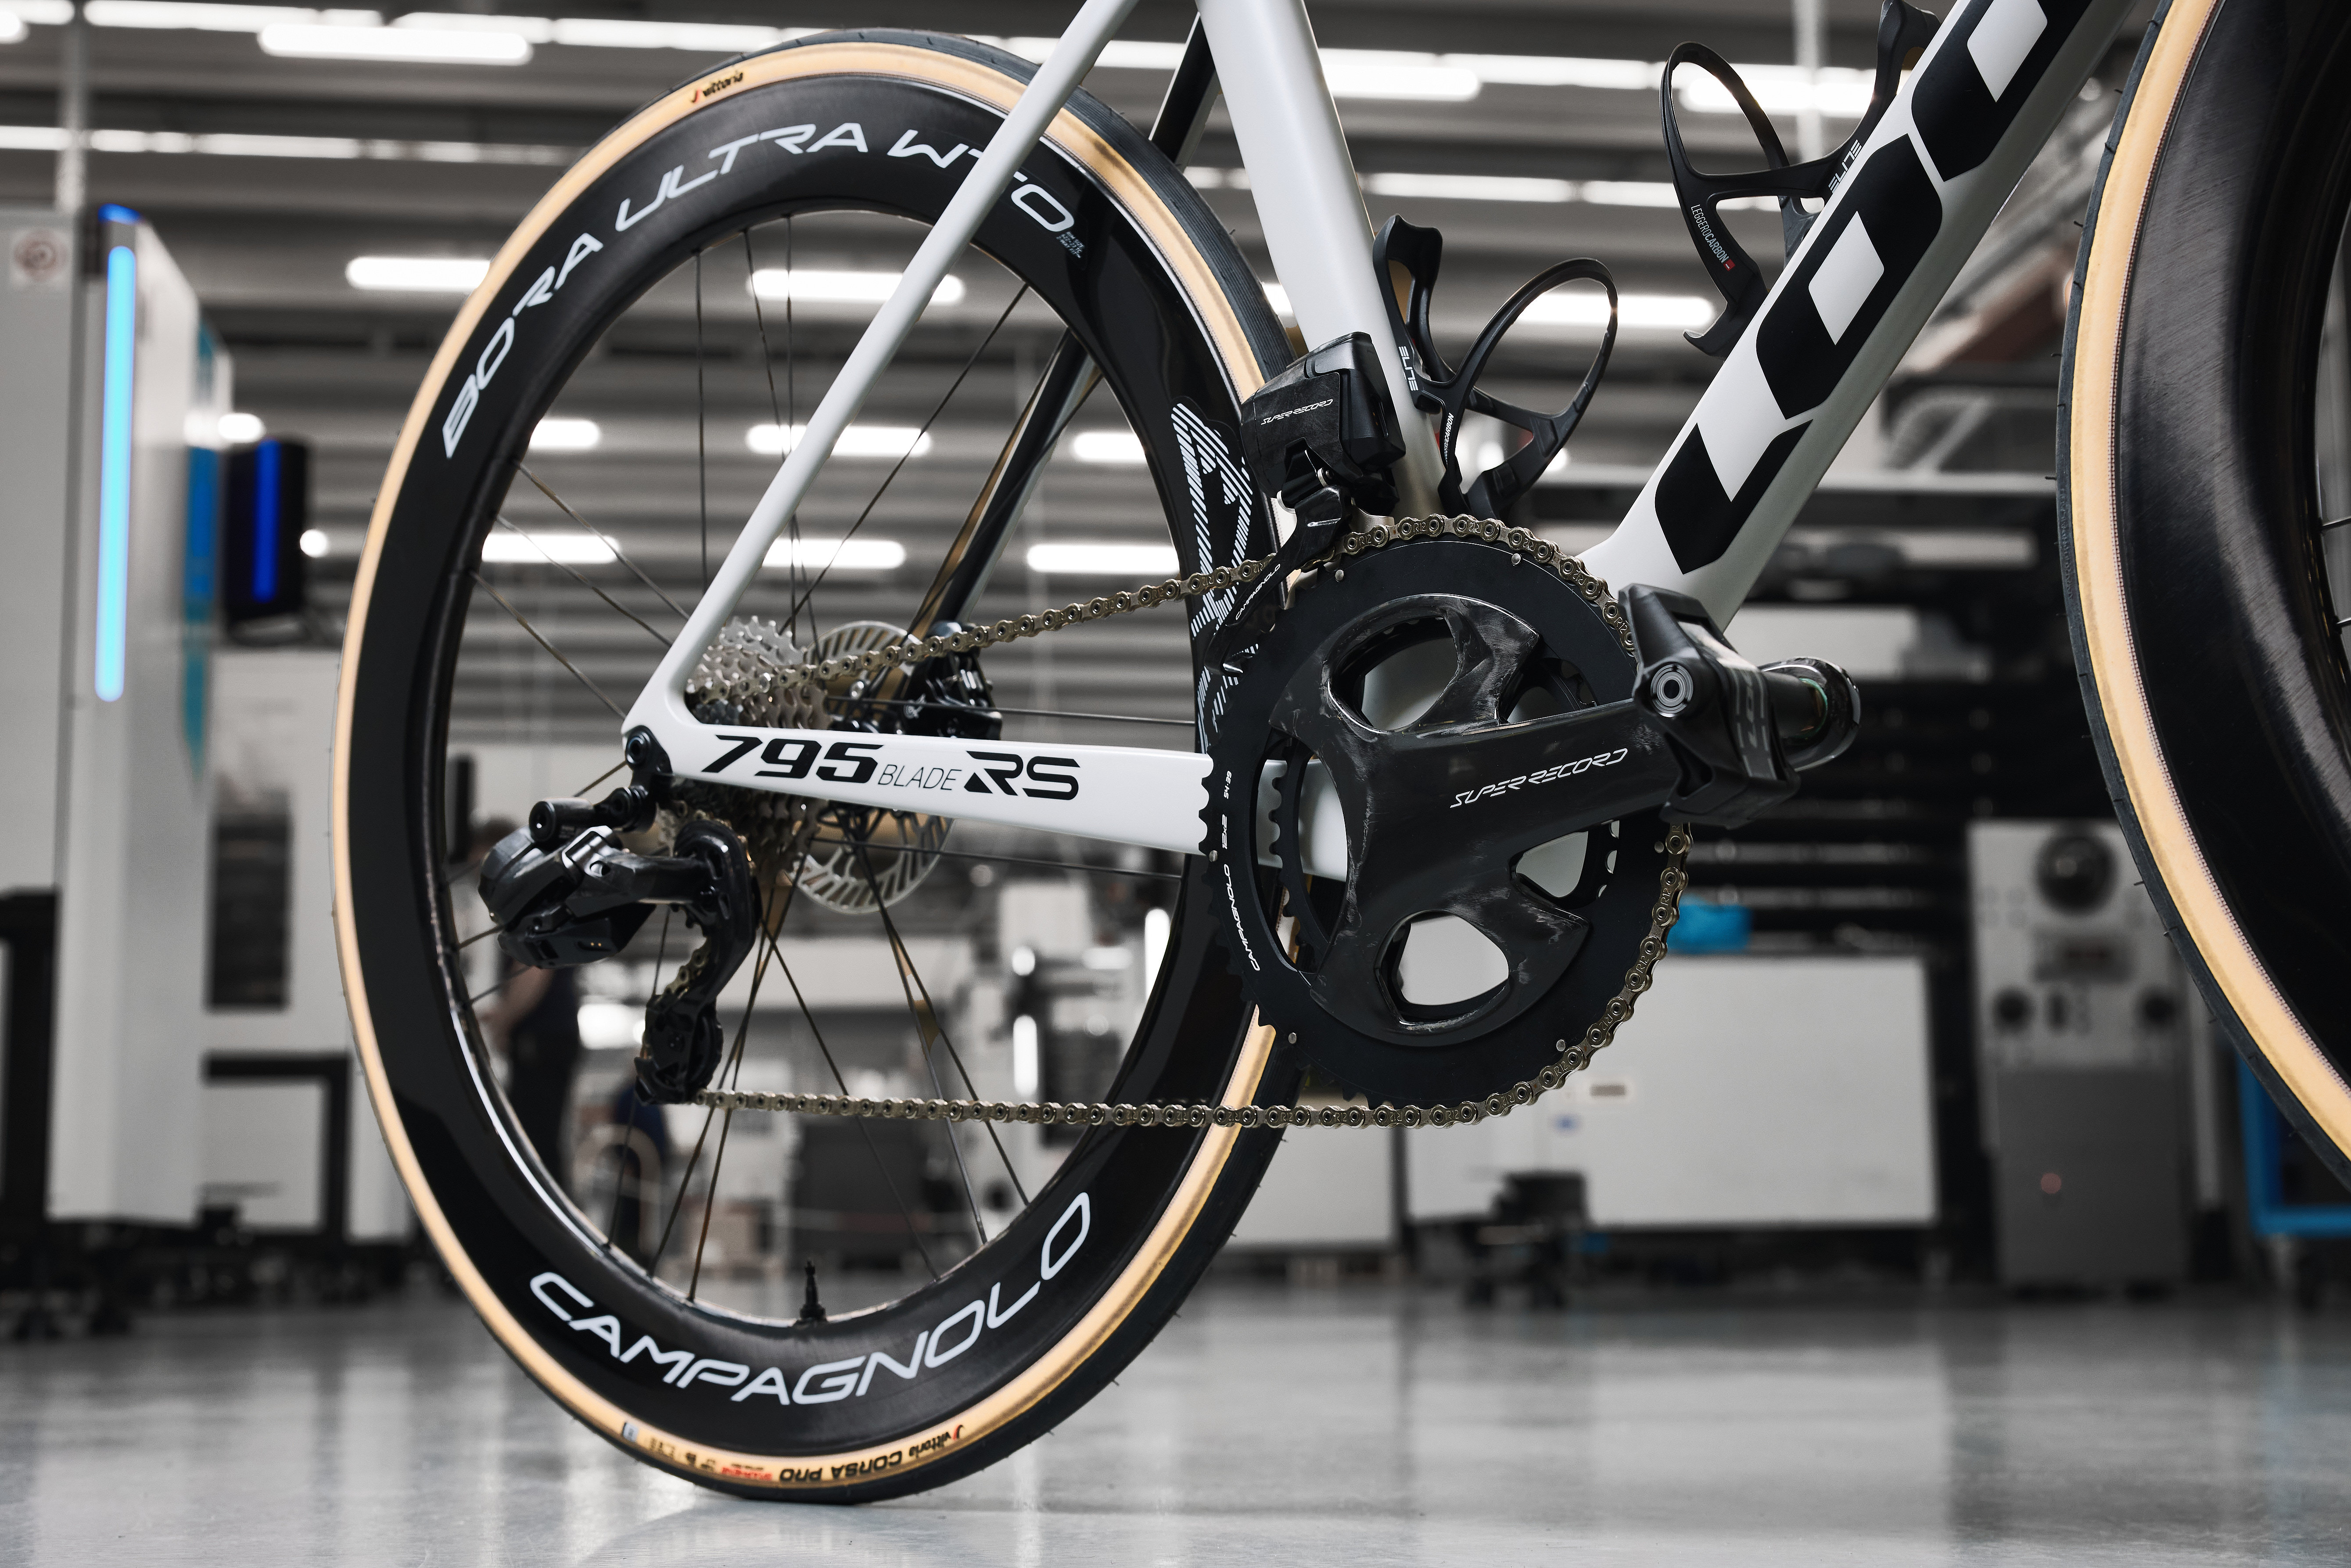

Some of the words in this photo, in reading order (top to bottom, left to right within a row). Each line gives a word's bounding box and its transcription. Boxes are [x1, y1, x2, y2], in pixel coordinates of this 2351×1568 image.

[1828, 139, 1862, 194] ELITE
[1691, 204, 1729, 263] LEGGEROCARBON
[442, 233, 604, 459] BORA
[615, 123, 868, 232] ULTRA
[887, 129, 1075, 232] WO
[1398, 346, 1418, 391] ELITE
[1260, 410, 1292, 425] SUPER
[1293, 398, 1333, 414] RECORD
[1413, 522, 1426, 532] R12
[1469, 520, 1482, 533] R12
[1359, 534, 1371, 545] R12
[1235, 563, 1280, 620] CAMPAGNOLO
[1614, 617, 1629, 634] R12
[701, 734, 884, 784] 795
[878, 763, 962, 791] BLADE
[964, 750, 1081, 800] RS
[1450, 775, 1526, 808] SUPER
[1528, 748, 1628, 784] RECORD
[1661, 888, 1672, 905] R12
[1224, 864, 1260, 971] CAMPAGNOLO
[1636, 955, 1649, 973] R12
[1599, 1013, 1613, 1030] R12
[1554, 1061, 1568, 1076] R12
[1281, 1112, 1293, 1122] R12
[1334, 1112, 1347, 1122] R12
[1446, 1109, 1459, 1120] R12
[530, 1192, 1091, 1405] CAMPAGNOLO
[831, 1450, 903, 1480] CORSA
[779, 1467, 822, 1483] PRO
